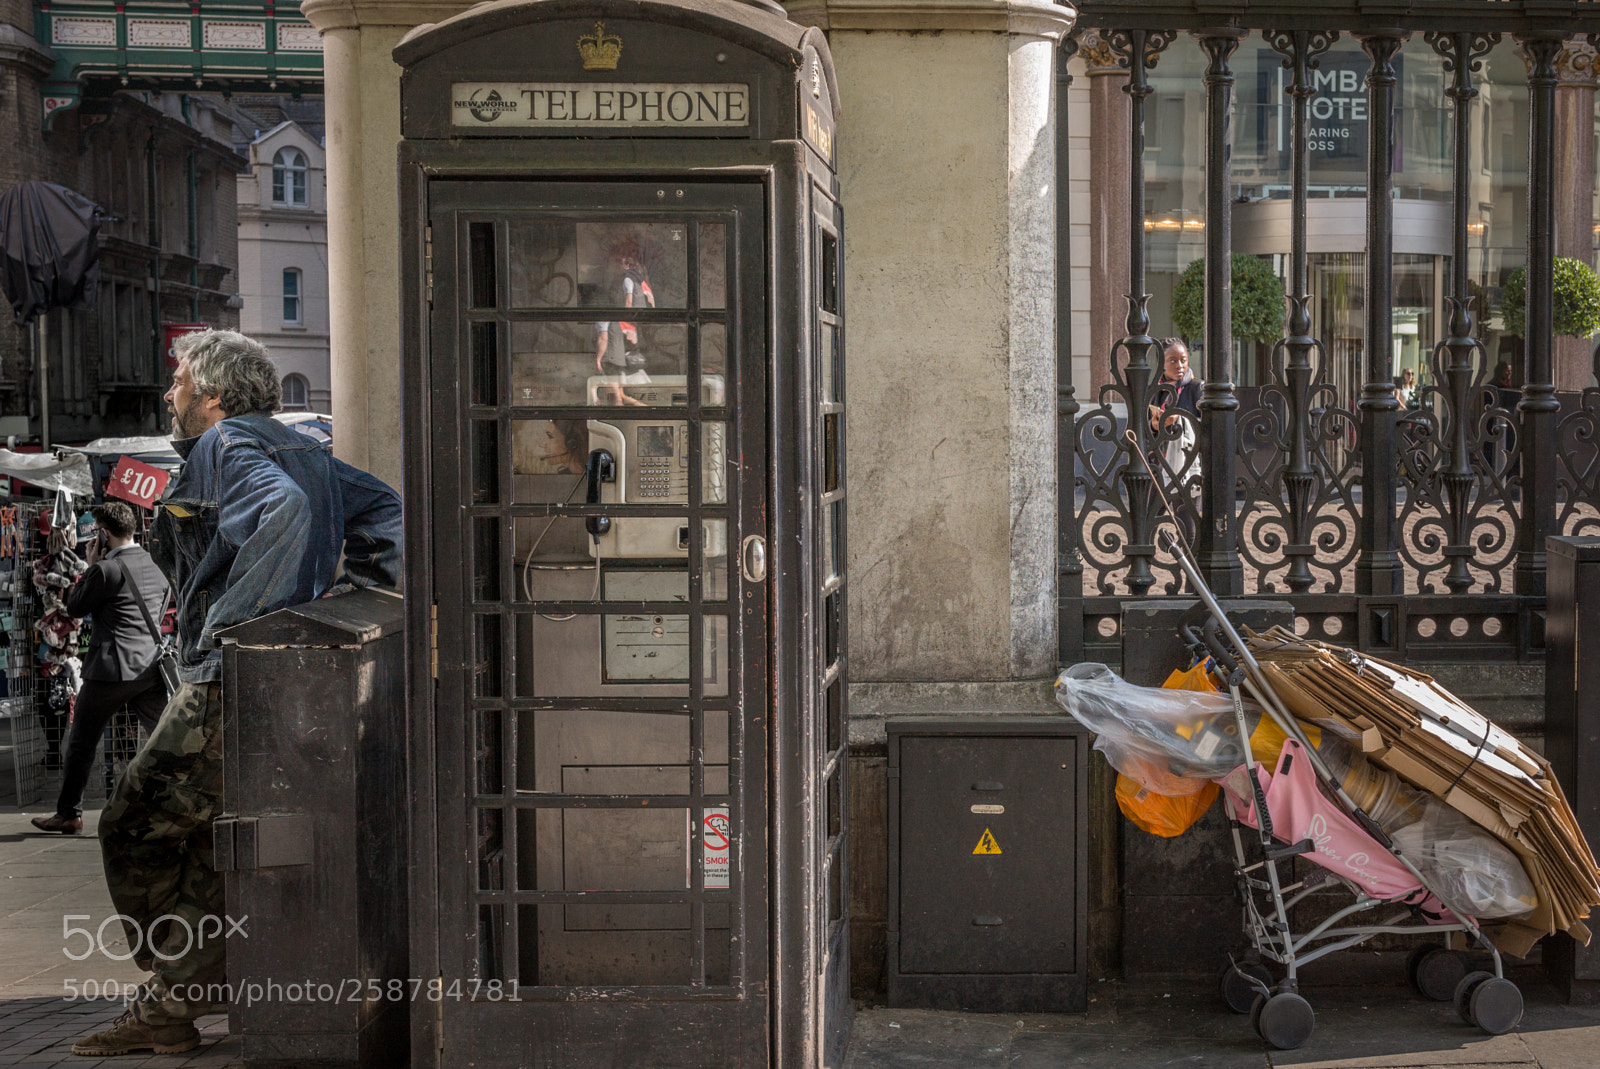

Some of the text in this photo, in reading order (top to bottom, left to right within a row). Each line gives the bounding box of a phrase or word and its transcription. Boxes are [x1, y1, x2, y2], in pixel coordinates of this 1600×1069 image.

[454, 100, 517, 108] NEW WORLD
[521, 89, 746, 122] TELEPHONE
[1290, 127, 1350, 138] ARING
[1290, 140, 1335, 151] OSS
[120, 468, 157, 499] £10
